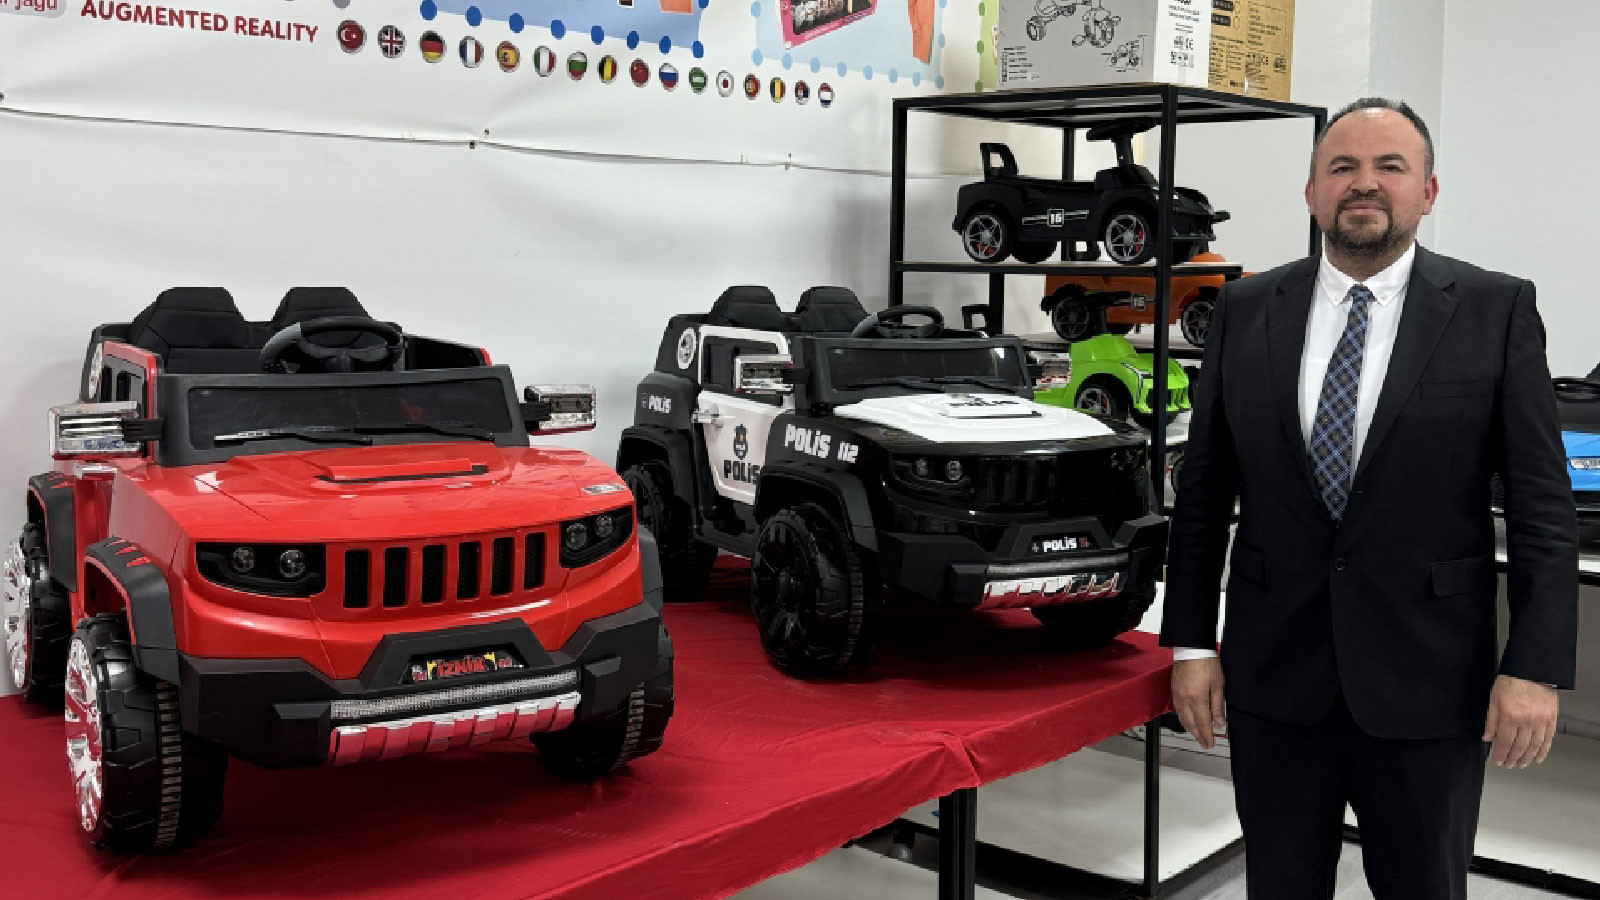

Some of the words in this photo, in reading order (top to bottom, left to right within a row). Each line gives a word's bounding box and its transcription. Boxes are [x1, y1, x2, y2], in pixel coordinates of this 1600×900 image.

[81, 0, 229, 32] AUGMENTED
[234, 15, 319, 43] REALITY
[837, 441, 859, 463] 112
